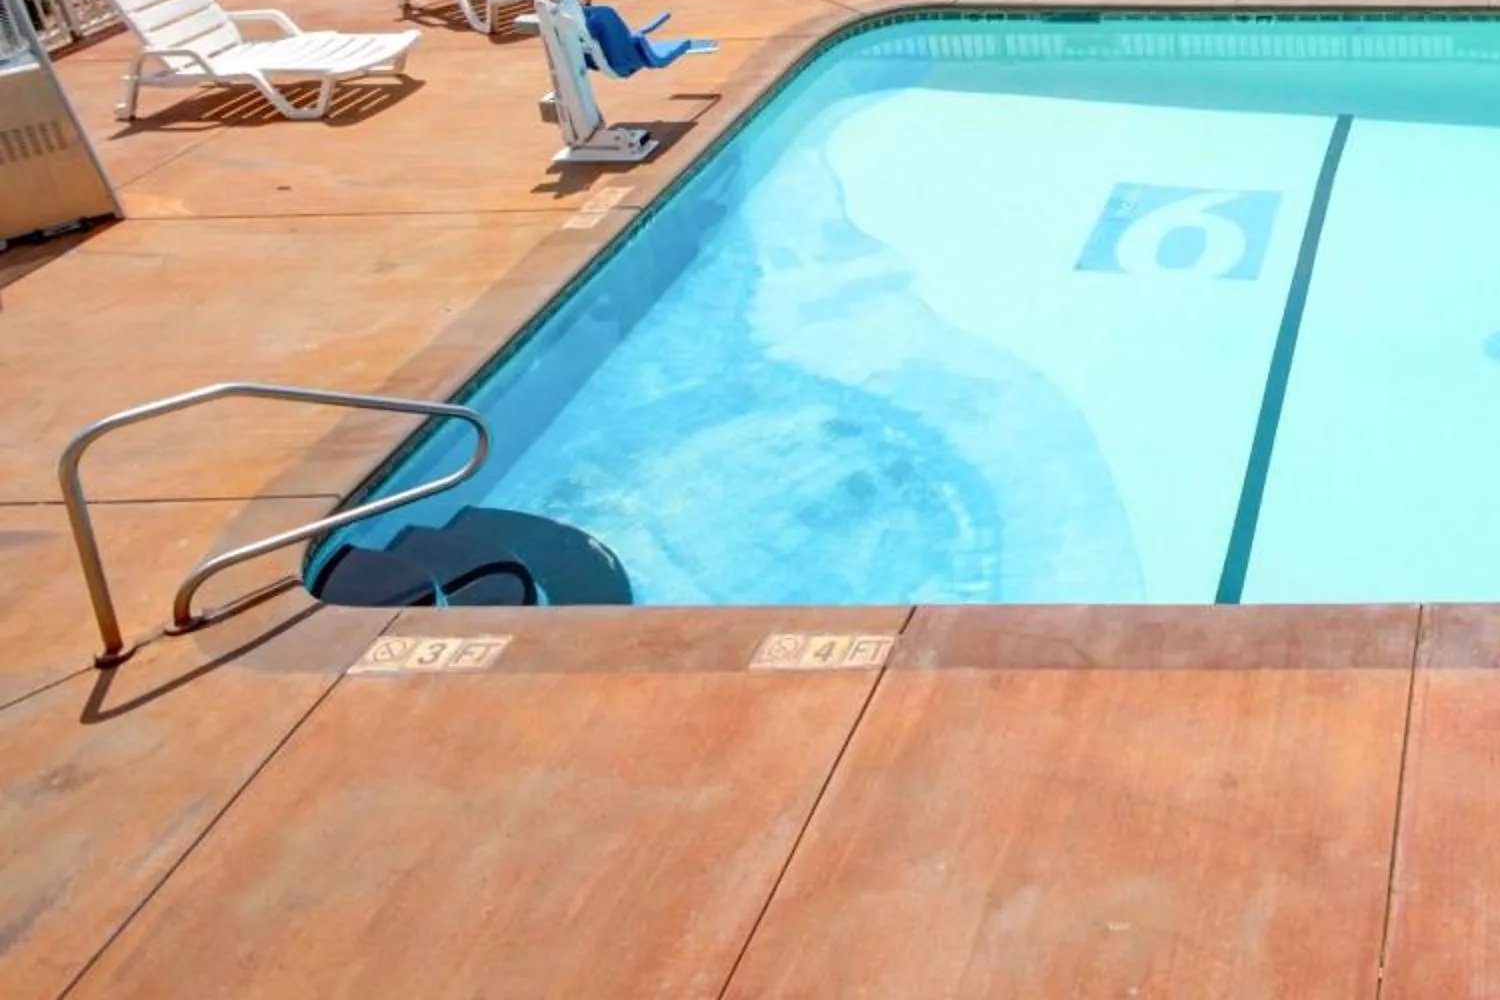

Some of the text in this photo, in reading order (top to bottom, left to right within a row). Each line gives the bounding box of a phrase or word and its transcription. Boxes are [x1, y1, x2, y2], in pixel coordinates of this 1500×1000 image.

[418, 642, 501, 664] 3 FT
[813, 639, 892, 662] 4 FT
